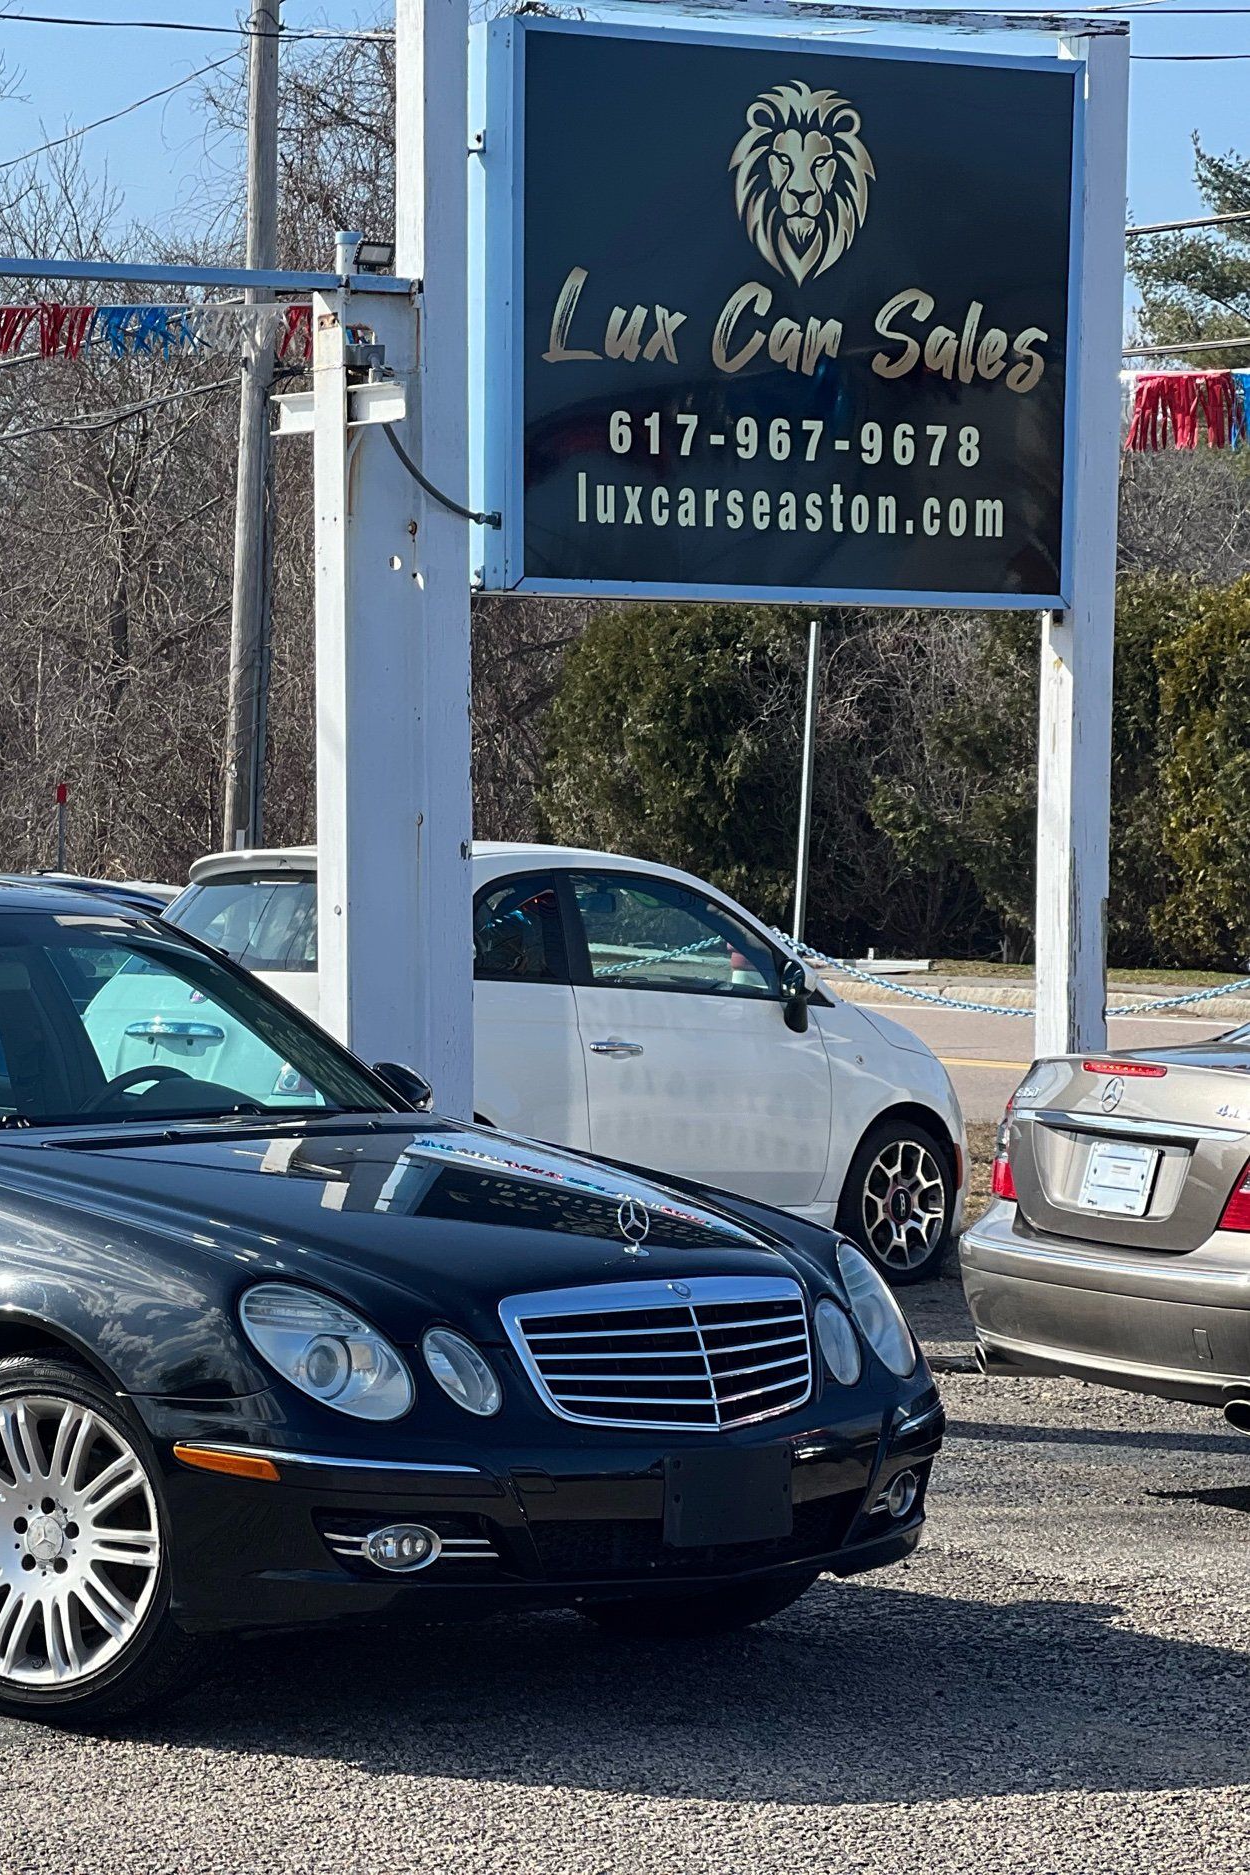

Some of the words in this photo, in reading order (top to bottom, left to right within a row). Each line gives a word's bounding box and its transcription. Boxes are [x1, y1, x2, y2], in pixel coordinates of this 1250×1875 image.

[541, 266, 688, 365] Lux
[712, 281, 843, 376] Car
[871, 287, 1048, 393] Sales
[609, 410, 980, 467] 617-967-9678
[577, 472, 1004, 538] luxcarseaston.com
